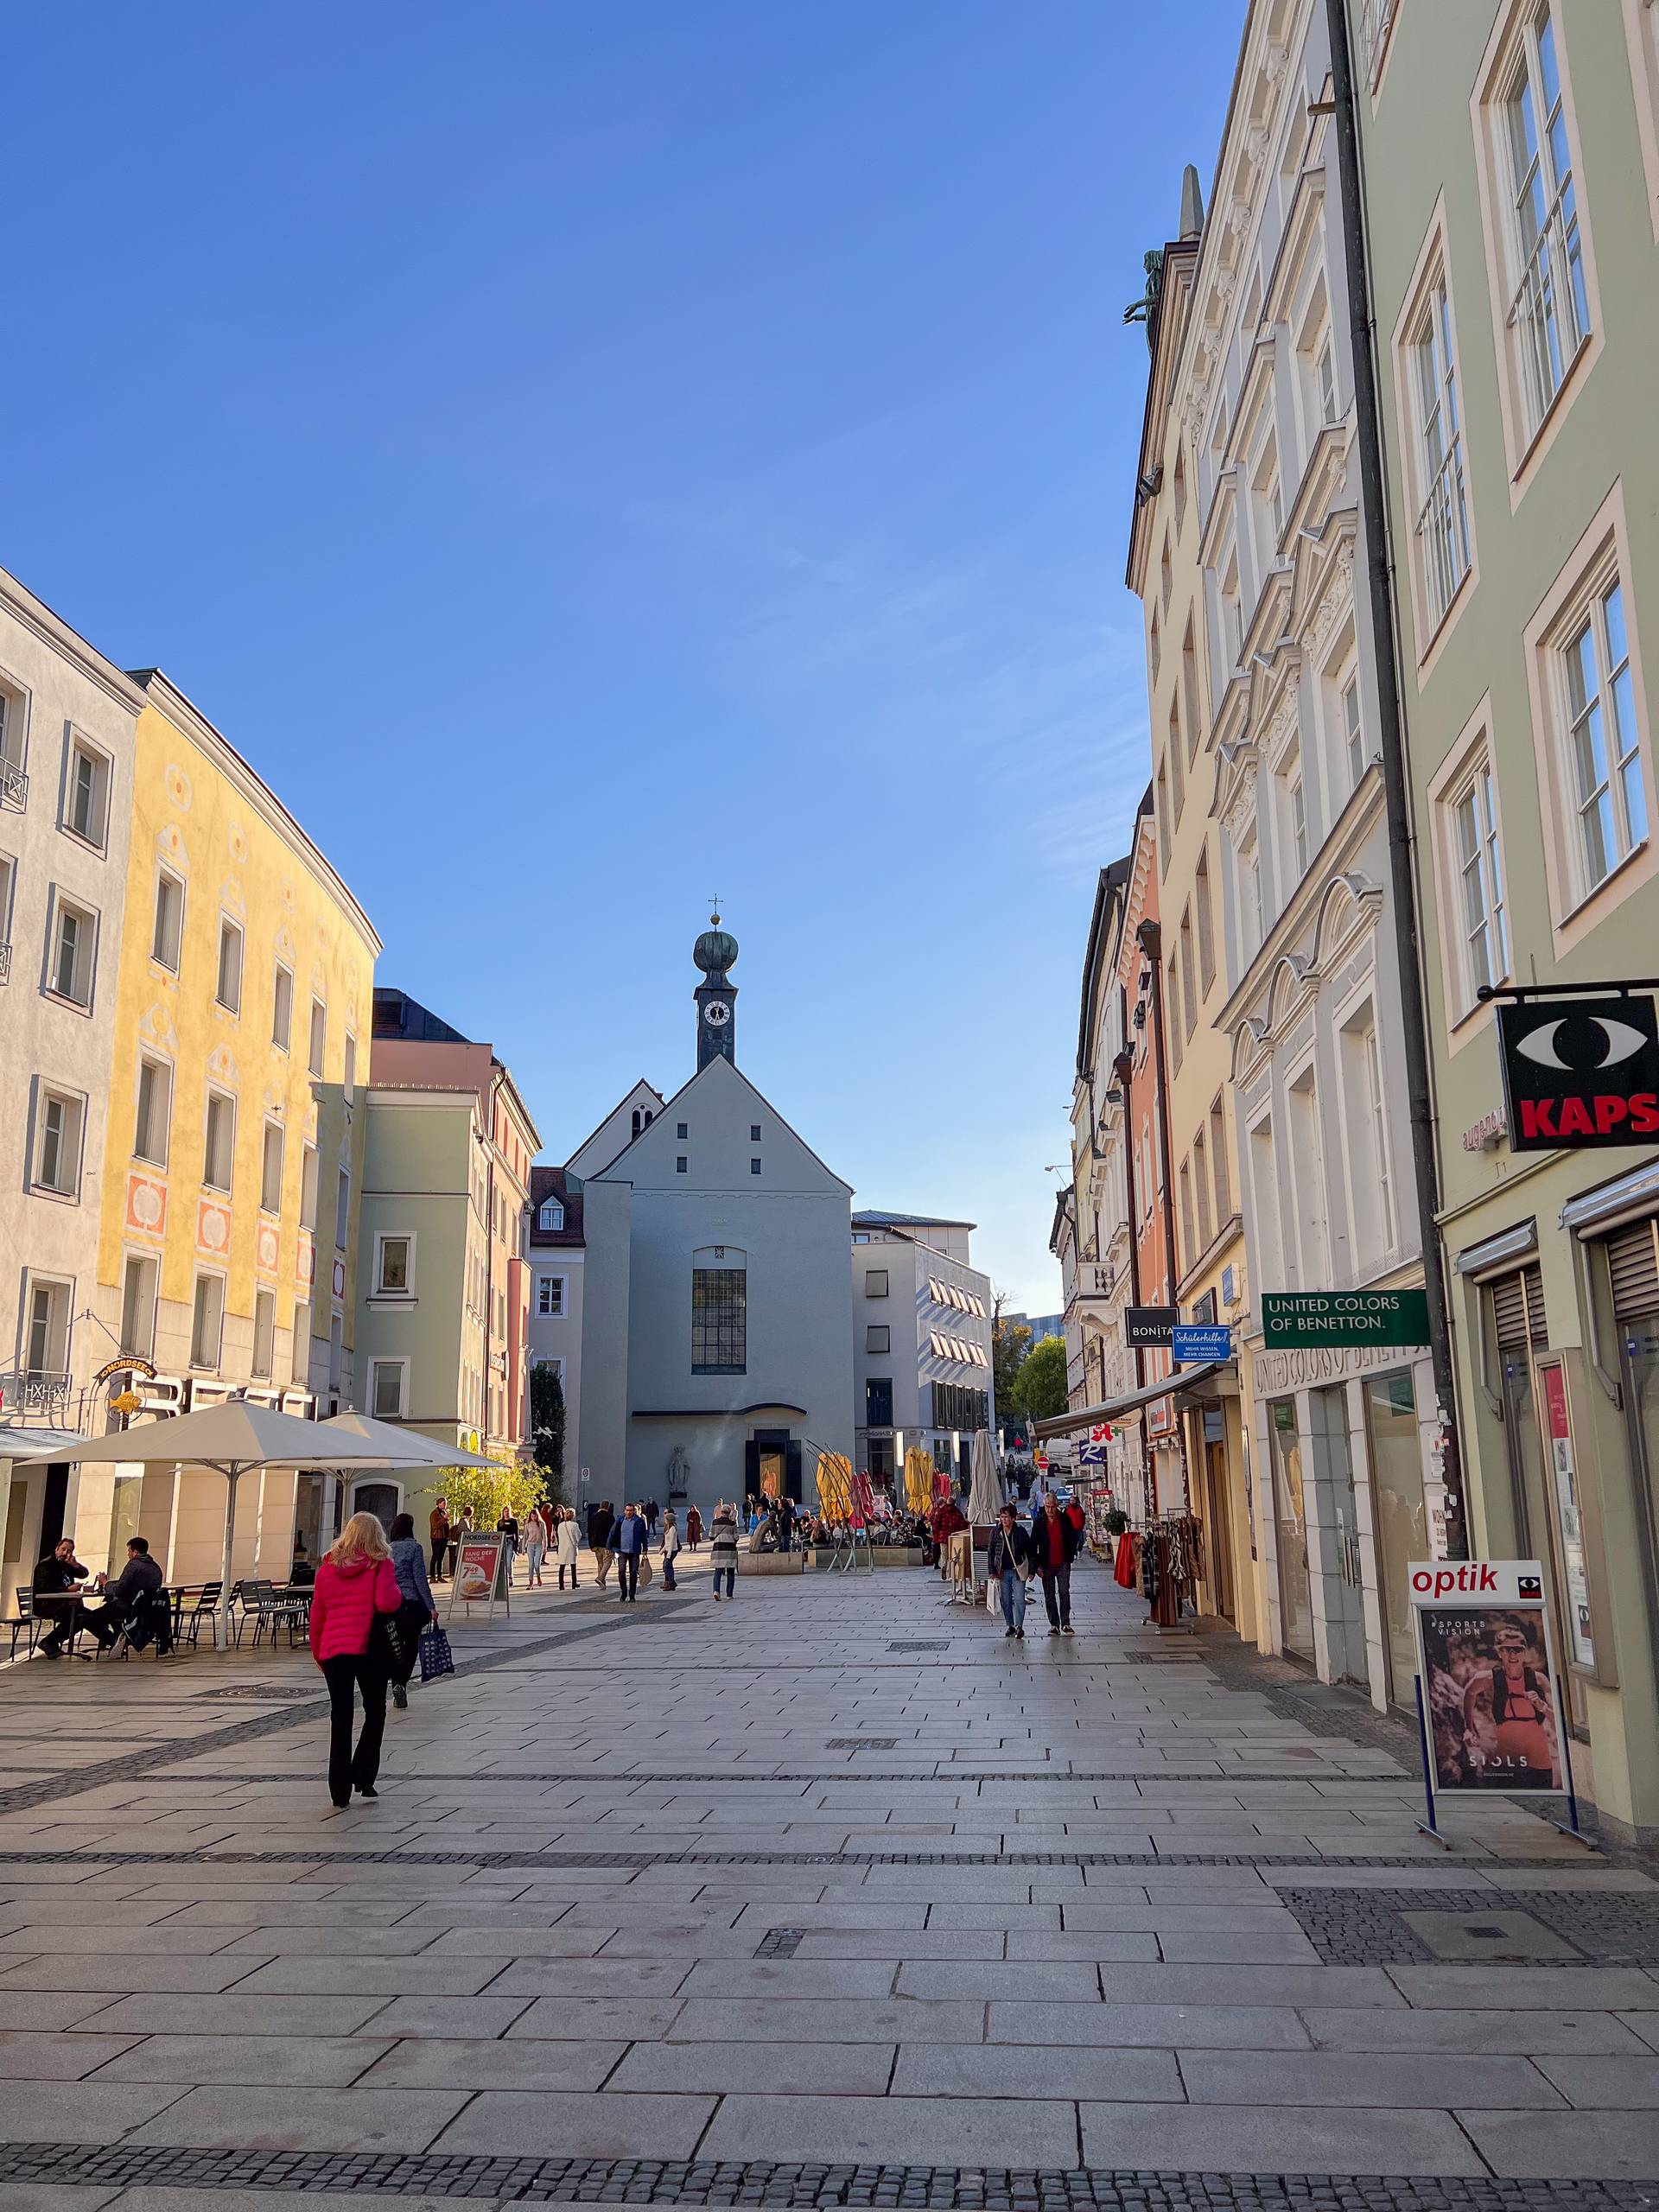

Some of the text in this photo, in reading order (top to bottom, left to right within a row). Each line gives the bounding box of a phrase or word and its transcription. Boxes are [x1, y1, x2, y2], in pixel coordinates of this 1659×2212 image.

[1463, 1105, 1507, 1151] augenop
[1521, 1093, 1659, 1138] KAPS
[1268, 1297, 1400, 1313] UNITED COLORS
[1270, 1315, 1386, 1332] OF BENETTON.
[106, 1359, 146, 1373] NORDSEE
[1412, 1563, 1498, 1599] optik
